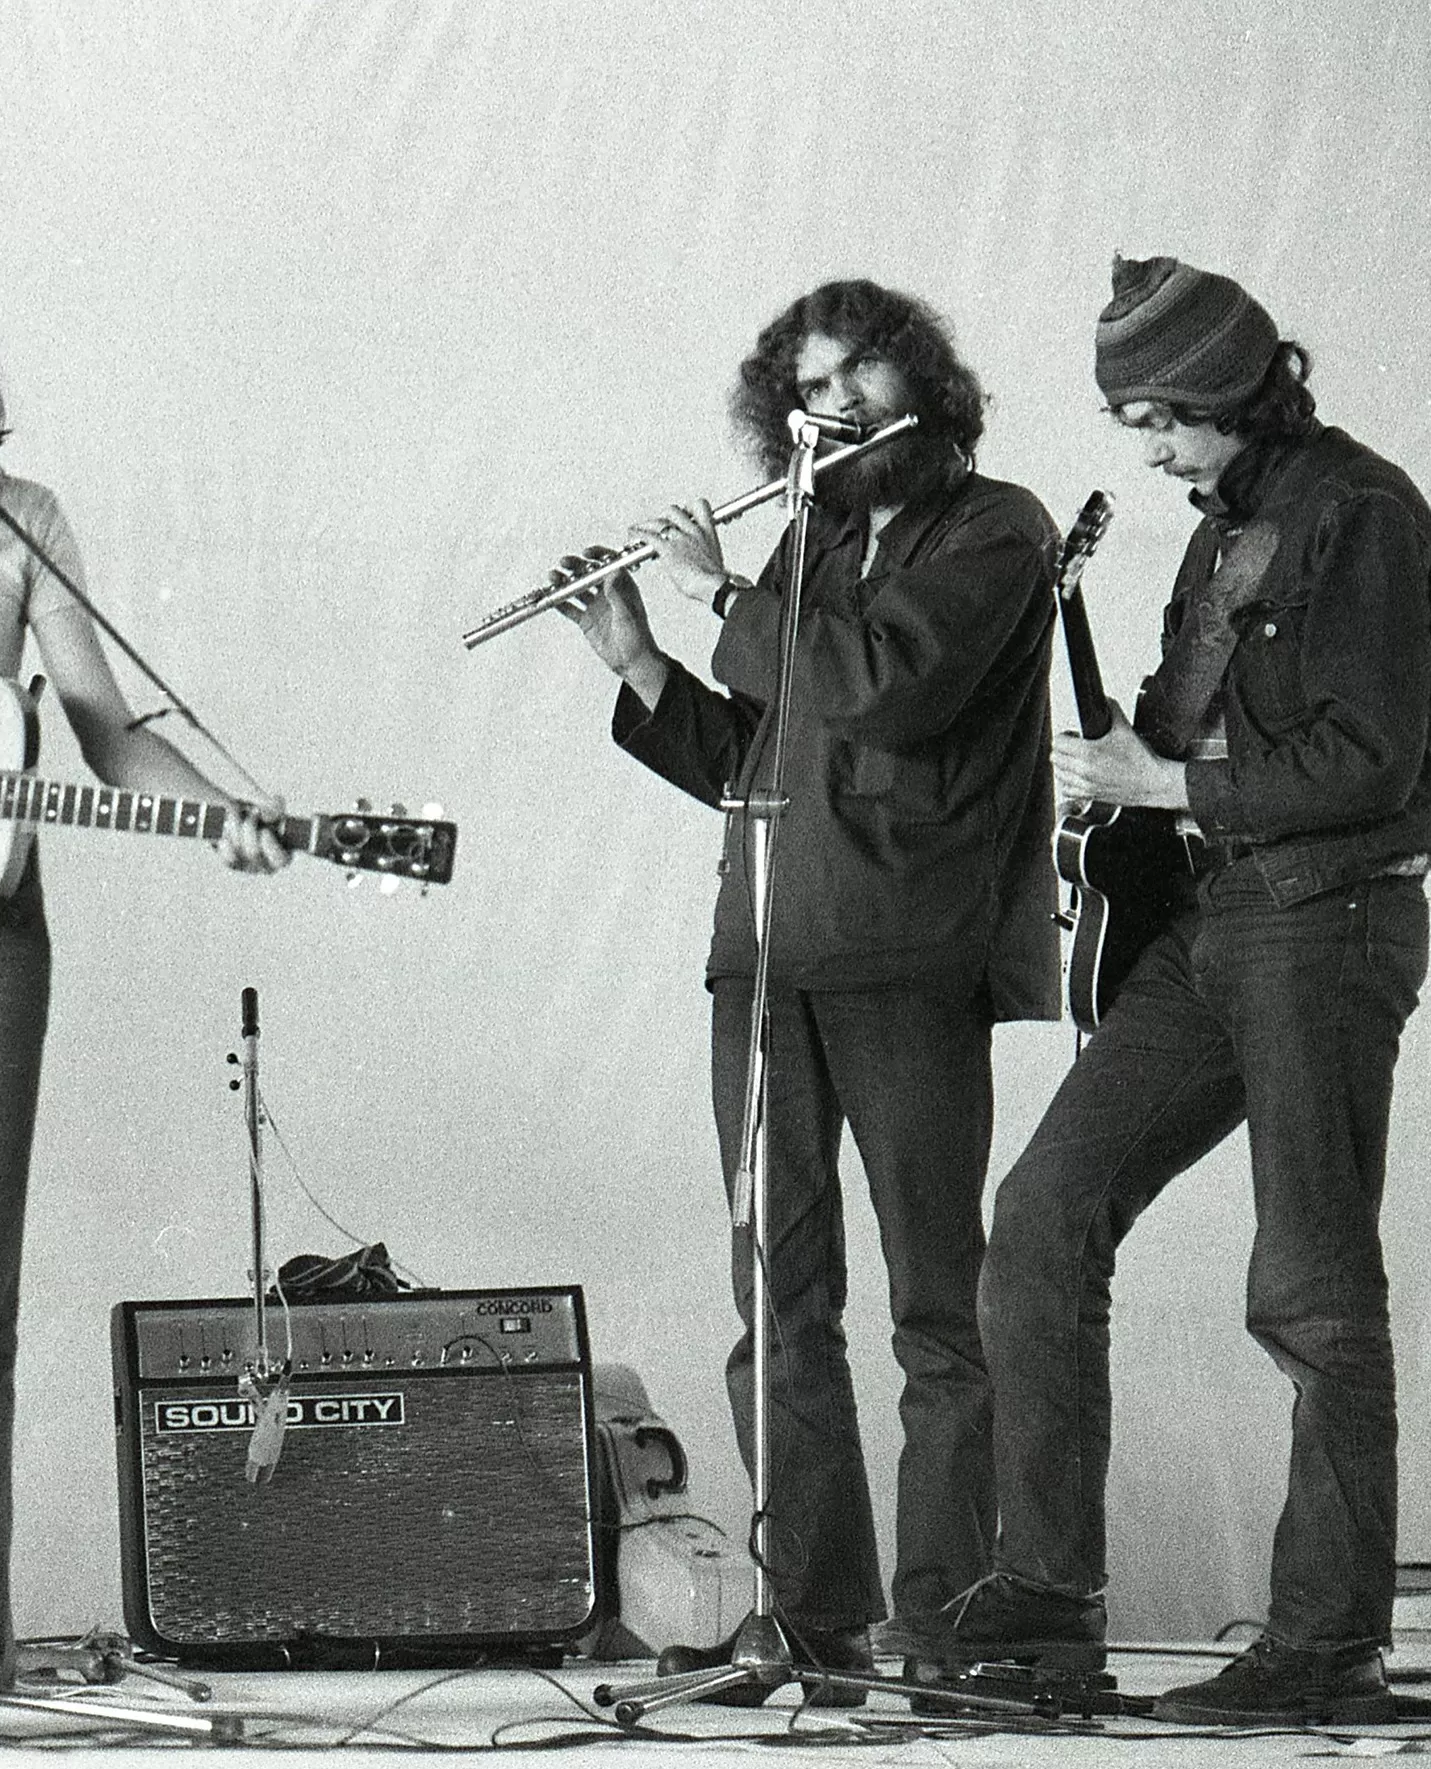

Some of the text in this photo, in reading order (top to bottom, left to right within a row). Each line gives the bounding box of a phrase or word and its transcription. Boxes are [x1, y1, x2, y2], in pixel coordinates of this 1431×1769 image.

[477, 1299, 553, 1316] CONCORD
[165, 1398, 395, 1428] SOUD CITY
